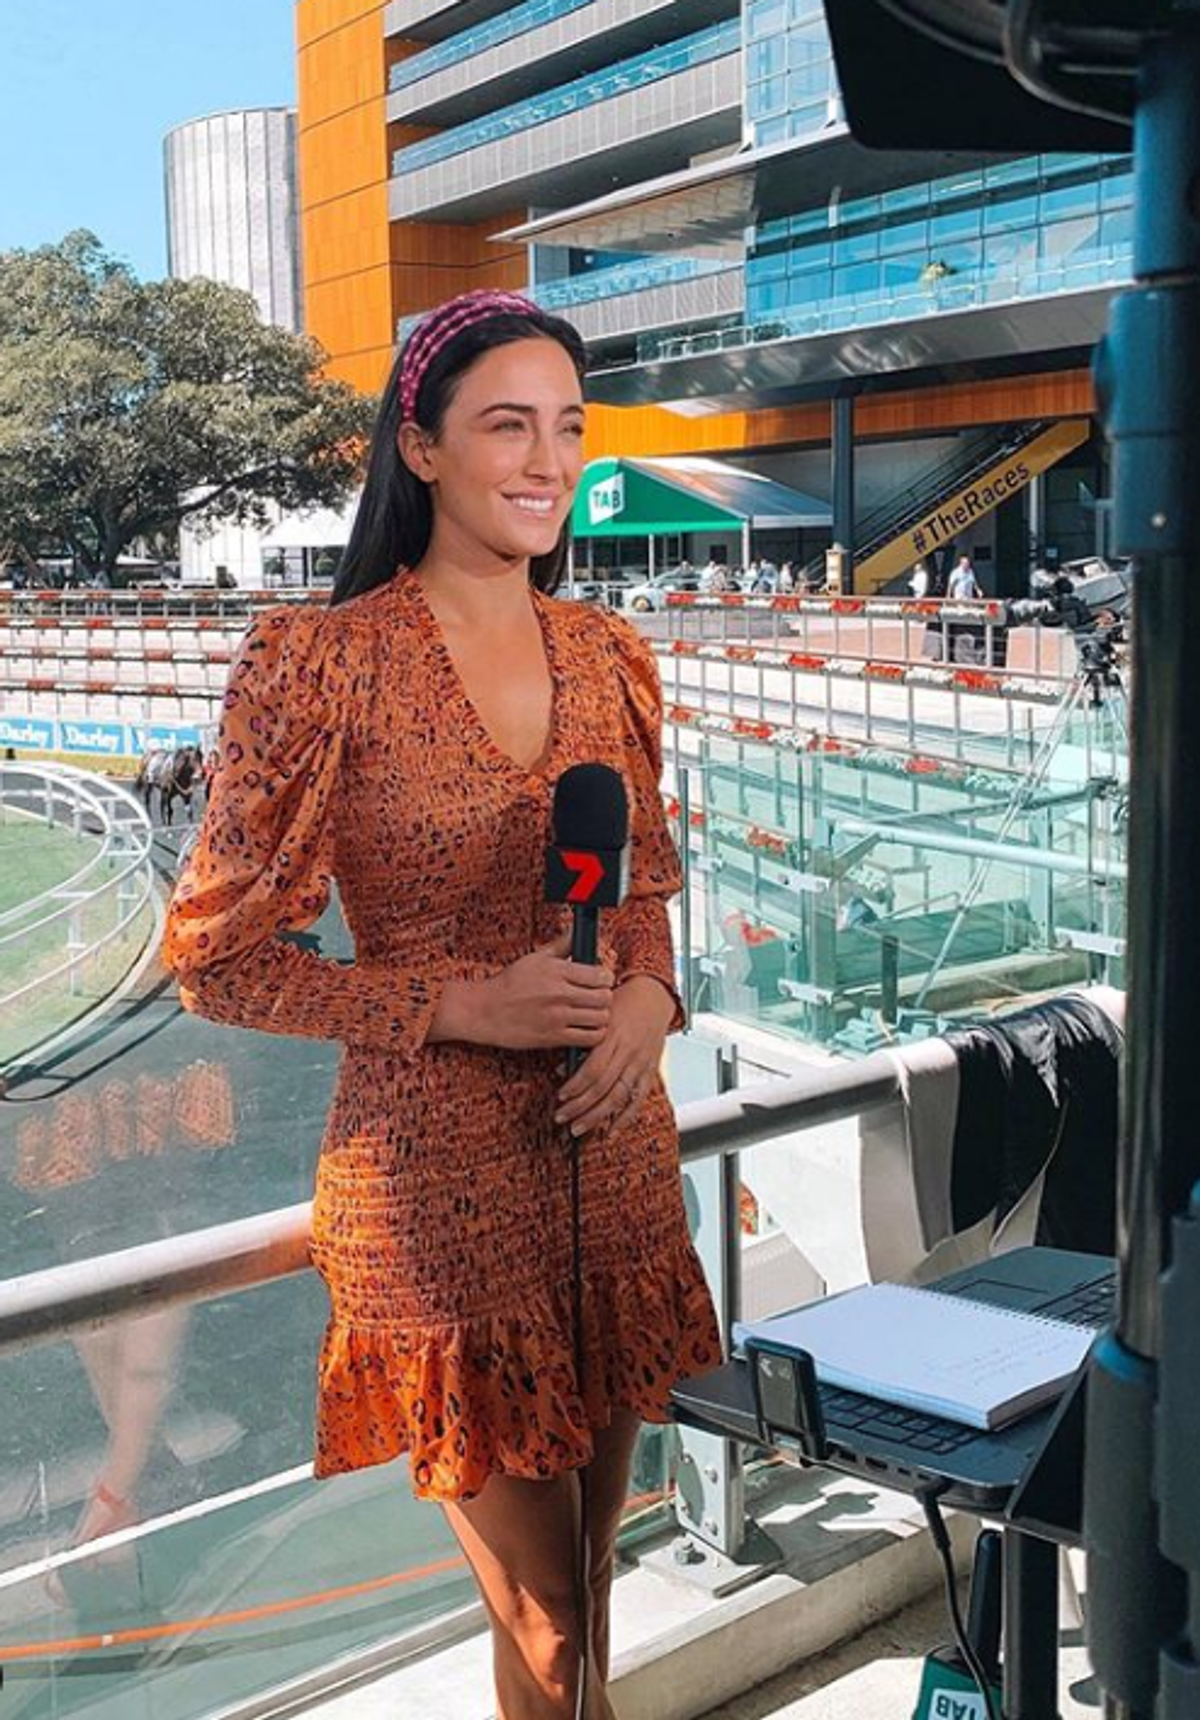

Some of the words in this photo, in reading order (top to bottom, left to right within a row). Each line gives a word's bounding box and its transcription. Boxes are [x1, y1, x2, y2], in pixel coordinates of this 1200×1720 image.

[593, 489, 620, 509] TAB
[912, 462, 1029, 555] #TheRaces
[562, 851, 605, 902] 7
